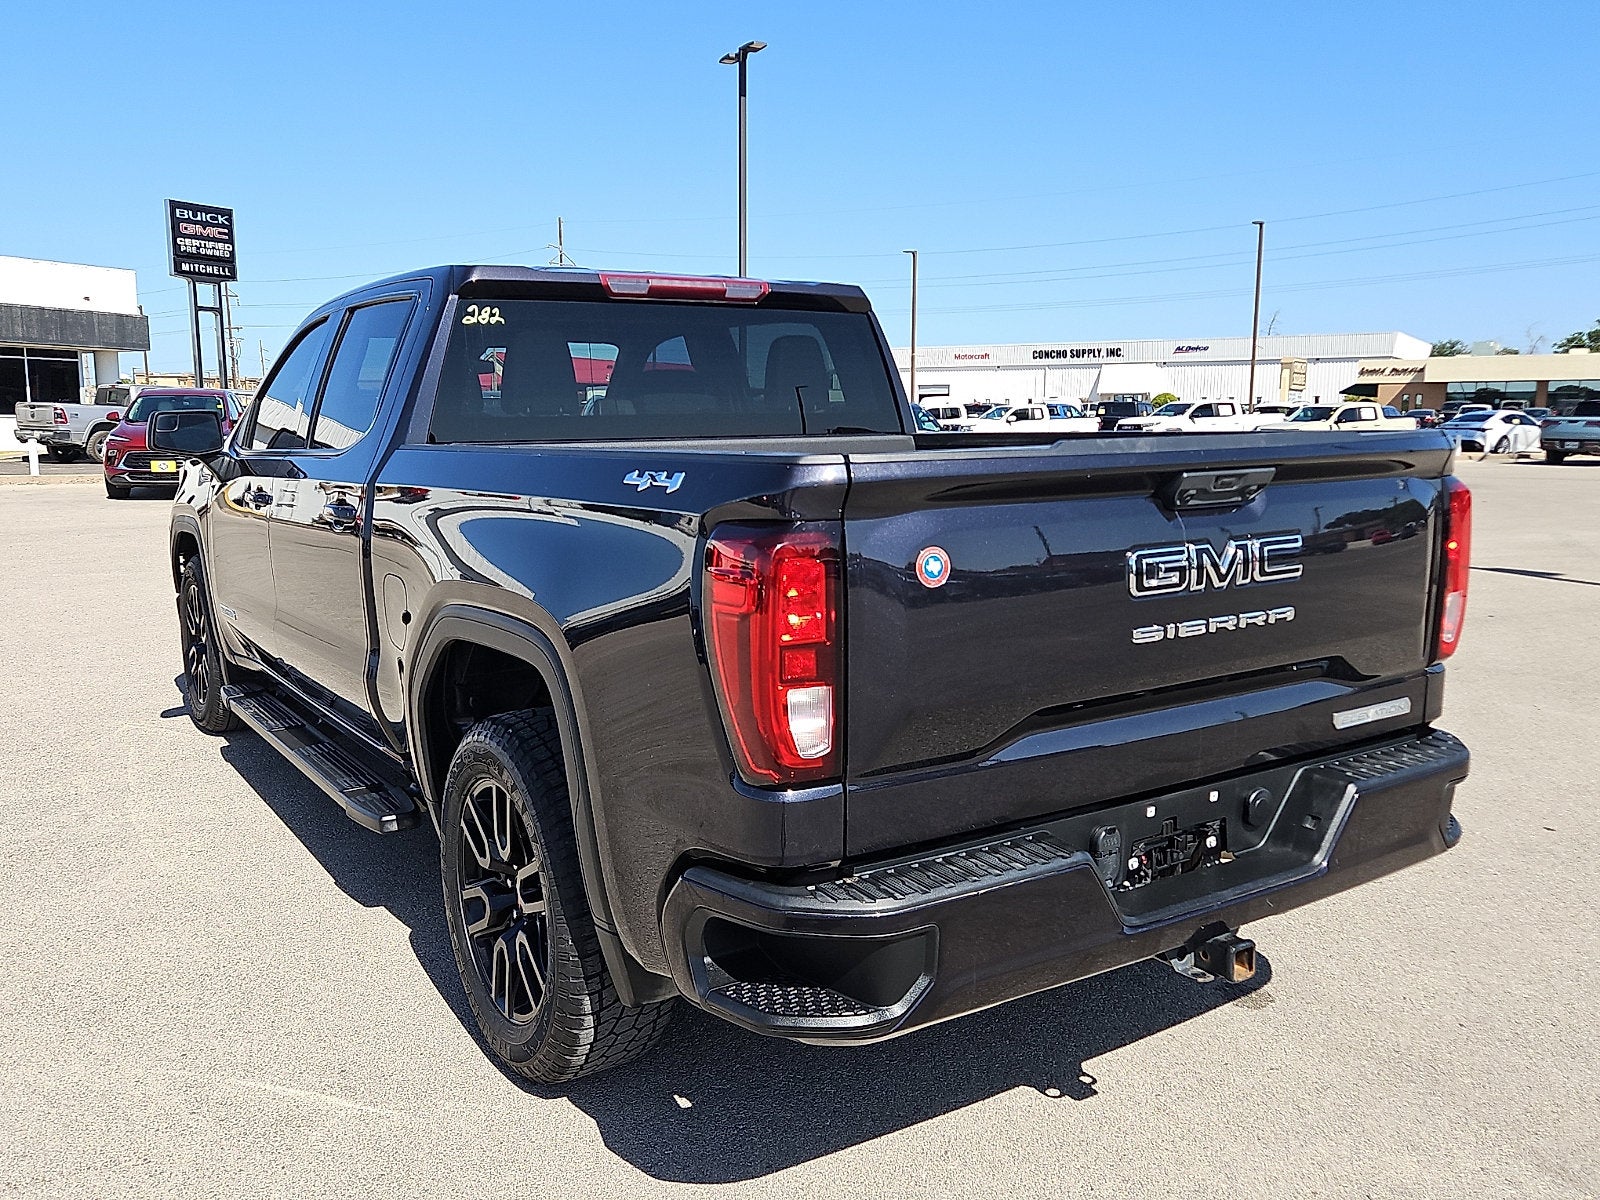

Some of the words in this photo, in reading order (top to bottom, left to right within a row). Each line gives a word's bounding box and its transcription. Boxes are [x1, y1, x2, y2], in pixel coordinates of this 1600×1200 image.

[175, 208, 230, 225] BUICK
[179, 222, 229, 240] GMC
[176, 237, 233, 252] CERTIFIED
[180, 245, 230, 258] PRE-OWNED
[181, 262, 231, 276] MITCHELL
[461, 304, 506, 325] 282
[954, 352, 990, 361] Motorcraft
[1032, 349, 1068, 360] CONCHO
[1069, 348, 1105, 360] SUPPLY,
[1106, 347, 1125, 358] INC.
[1126, 534, 1304, 599] GMC
[1131, 606, 1296, 645] SIERRA
